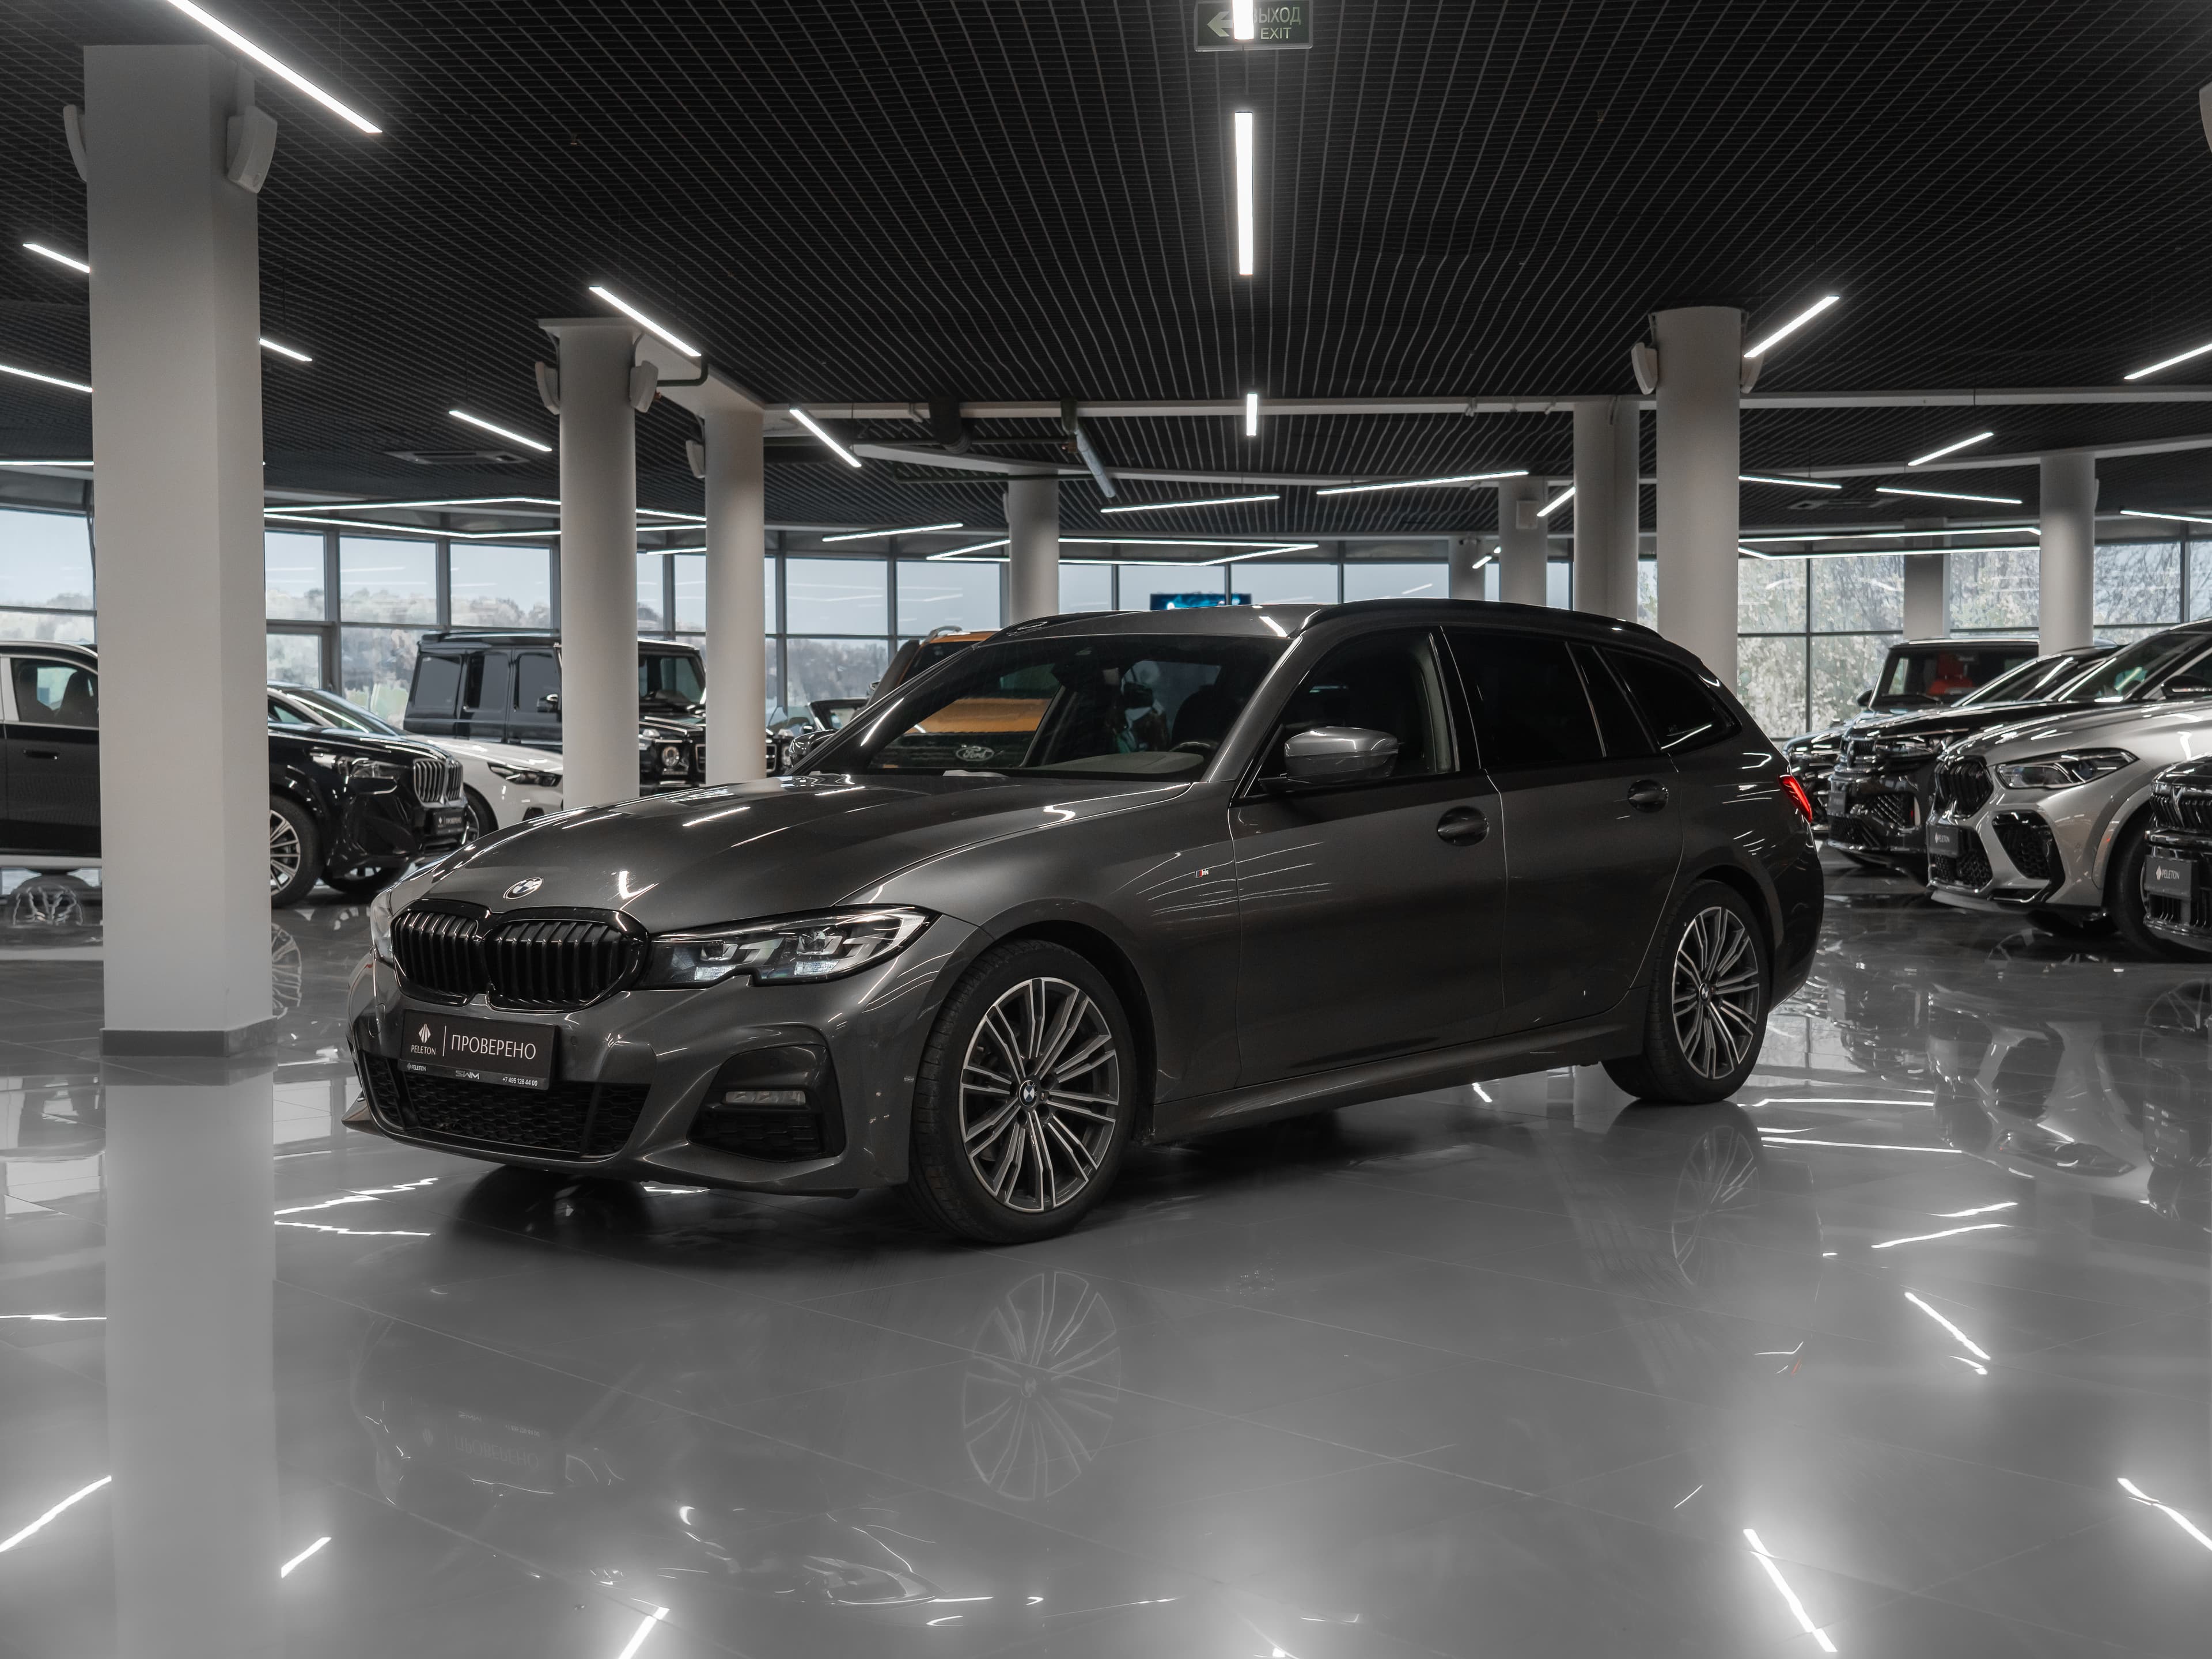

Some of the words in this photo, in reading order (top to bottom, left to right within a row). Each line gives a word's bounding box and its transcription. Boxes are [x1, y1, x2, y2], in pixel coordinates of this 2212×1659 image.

[1260, 28, 1292, 39] EXIT
[2162, 869, 2180, 880] PELETON
[411, 1044, 437, 1055] PELETON
[451, 1035, 536, 1060] ПРОВЕРЕНО
[455, 1070, 480, 1080] SWM
